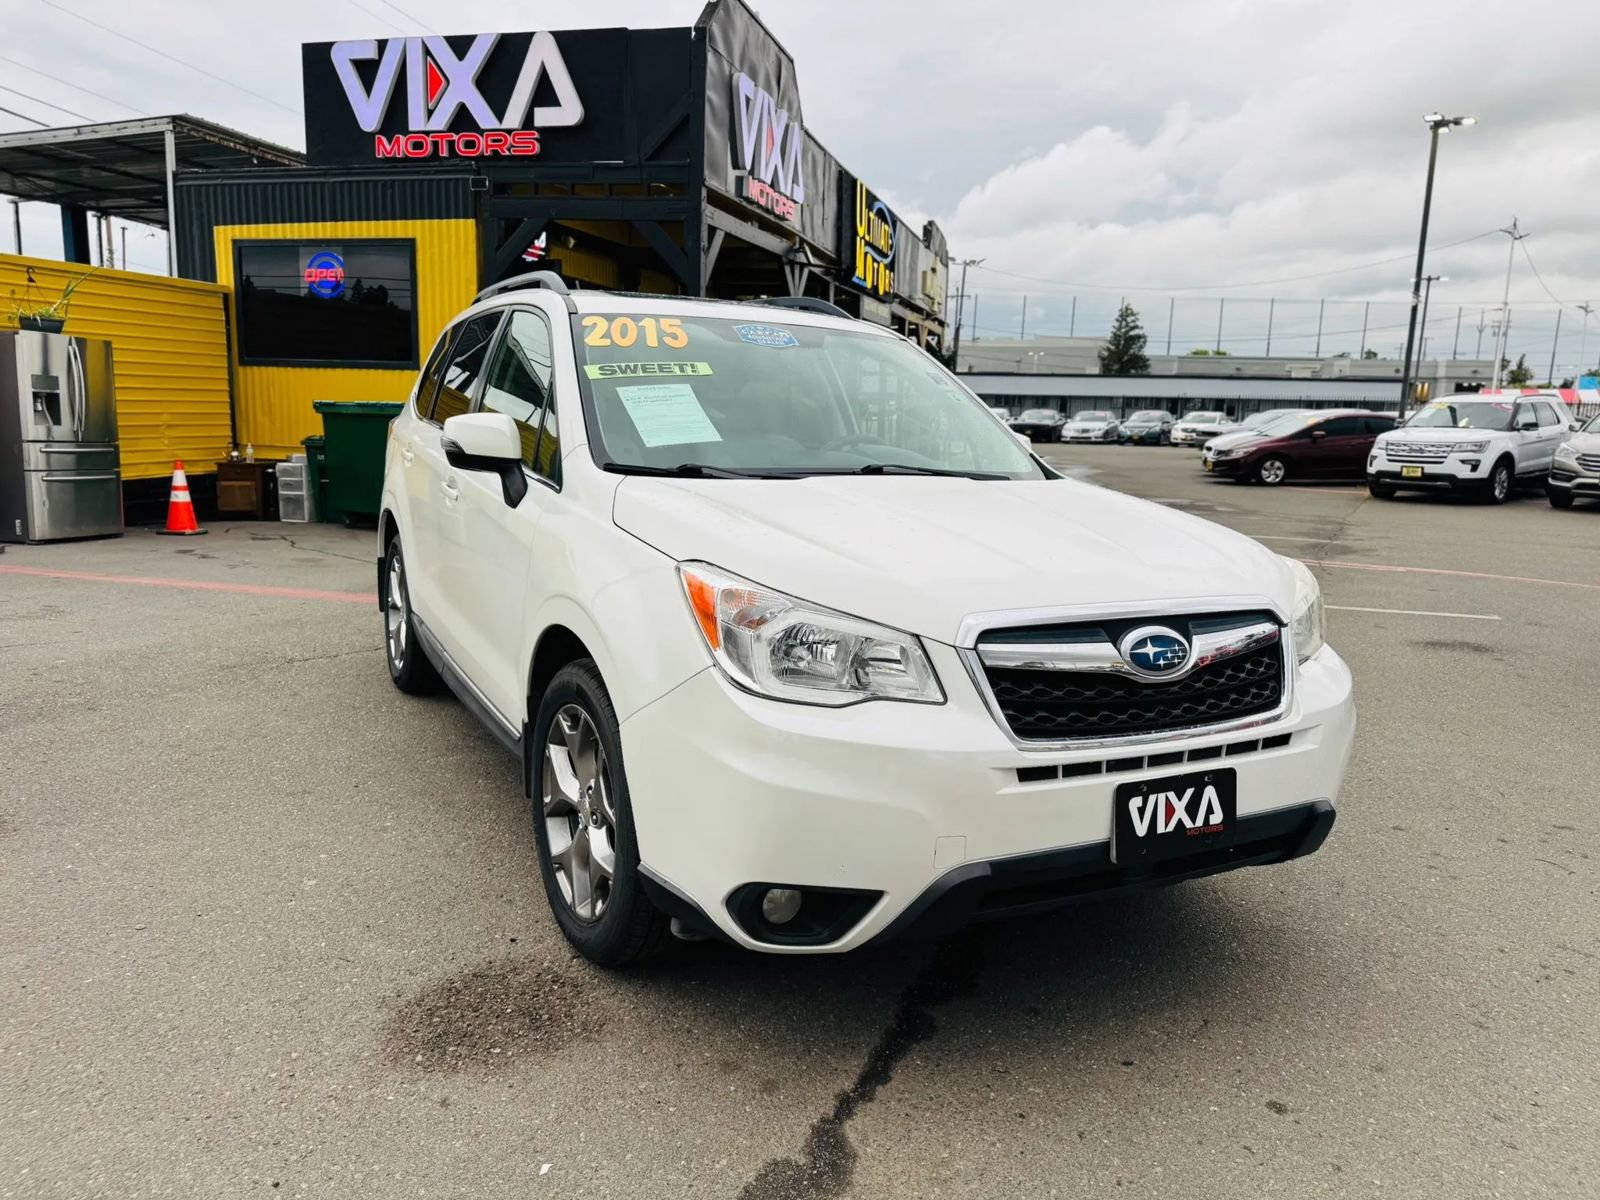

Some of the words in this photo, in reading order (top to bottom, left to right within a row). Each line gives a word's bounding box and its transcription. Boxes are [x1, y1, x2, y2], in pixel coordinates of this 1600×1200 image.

[331, 30, 584, 133] VIXA
[375, 130, 541, 158] MOTORS
[732, 72, 804, 204] VIXA
[748, 175, 796, 221] MOTORS
[856, 178, 893, 256] ULTIMATE
[856, 235, 894, 296] MOTORS
[581, 316, 688, 349] 2015
[598, 363, 697, 377] SWEET!
[1128, 784, 1224, 837] VIXA
[1186, 824, 1224, 836] MOTORS
